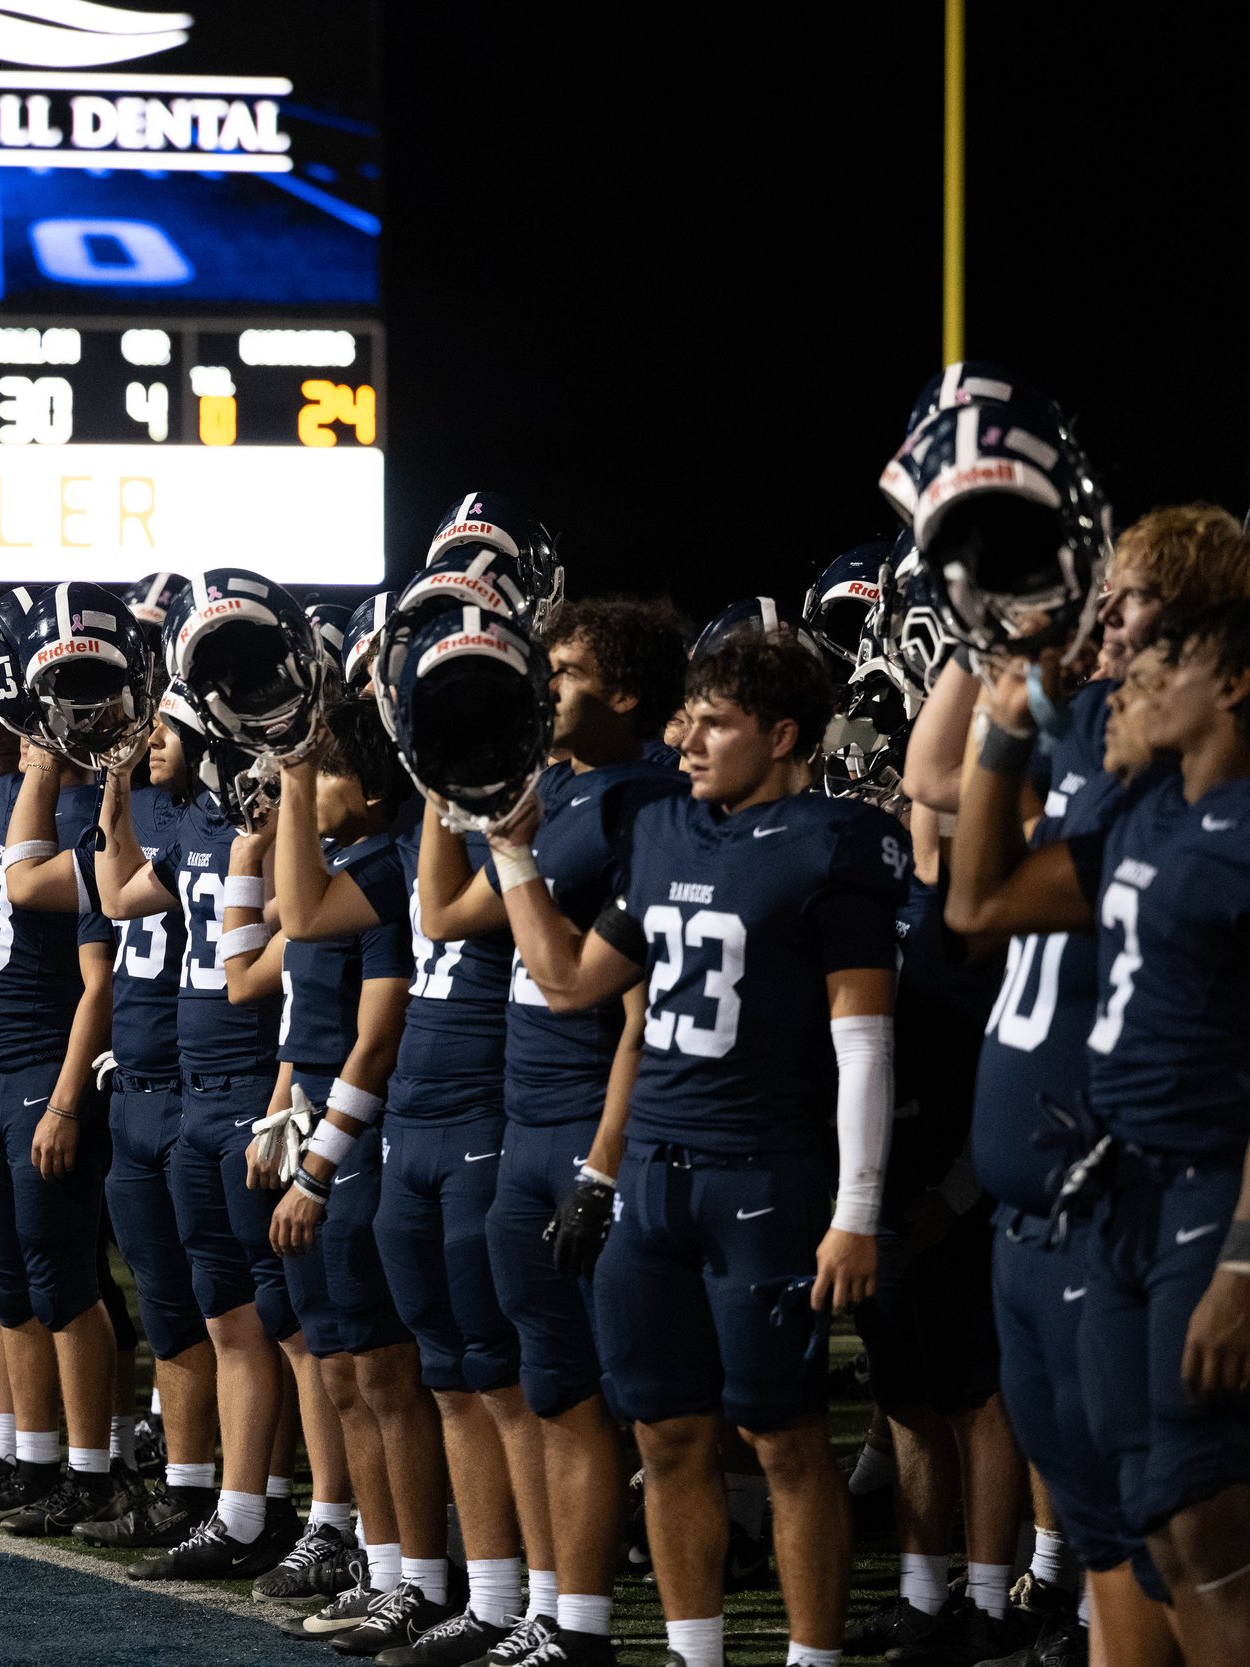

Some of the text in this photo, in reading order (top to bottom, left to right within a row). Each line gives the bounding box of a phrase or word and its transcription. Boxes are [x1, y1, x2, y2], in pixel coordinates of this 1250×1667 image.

[70, 96, 291, 152] DENTAL
[29, 217, 196, 287] 0
[125, 382, 169, 442] 4
[297, 379, 376, 447] 24
[430, 573, 502, 609] Riddell
[180, 599, 242, 644] Rdell
[436, 635, 508, 654] Riddell
[36, 640, 100, 665] Riddell
[668, 881, 715, 905] RANGERS
[177, 870, 228, 990] 13
[643, 905, 748, 1059] 23
